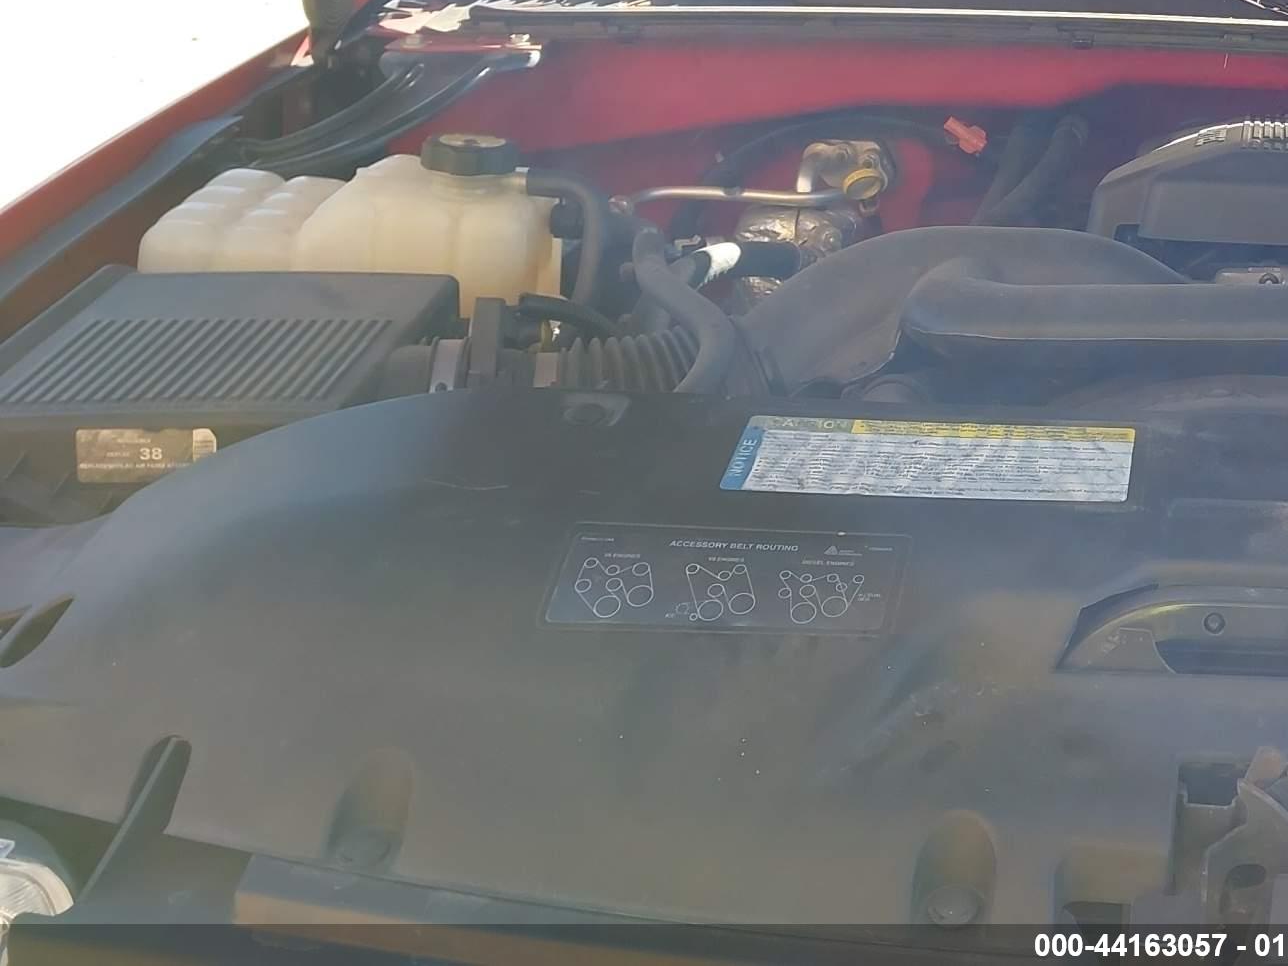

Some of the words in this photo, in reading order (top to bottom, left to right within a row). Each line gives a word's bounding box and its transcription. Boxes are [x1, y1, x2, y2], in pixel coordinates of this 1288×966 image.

[139, 447, 163, 460] 38
[728, 439, 757, 476] NOTICE
[669, 540, 728, 549] ACCESSORY
[730, 542, 754, 550] BELT
[756, 544, 799, 552] ROUTING
